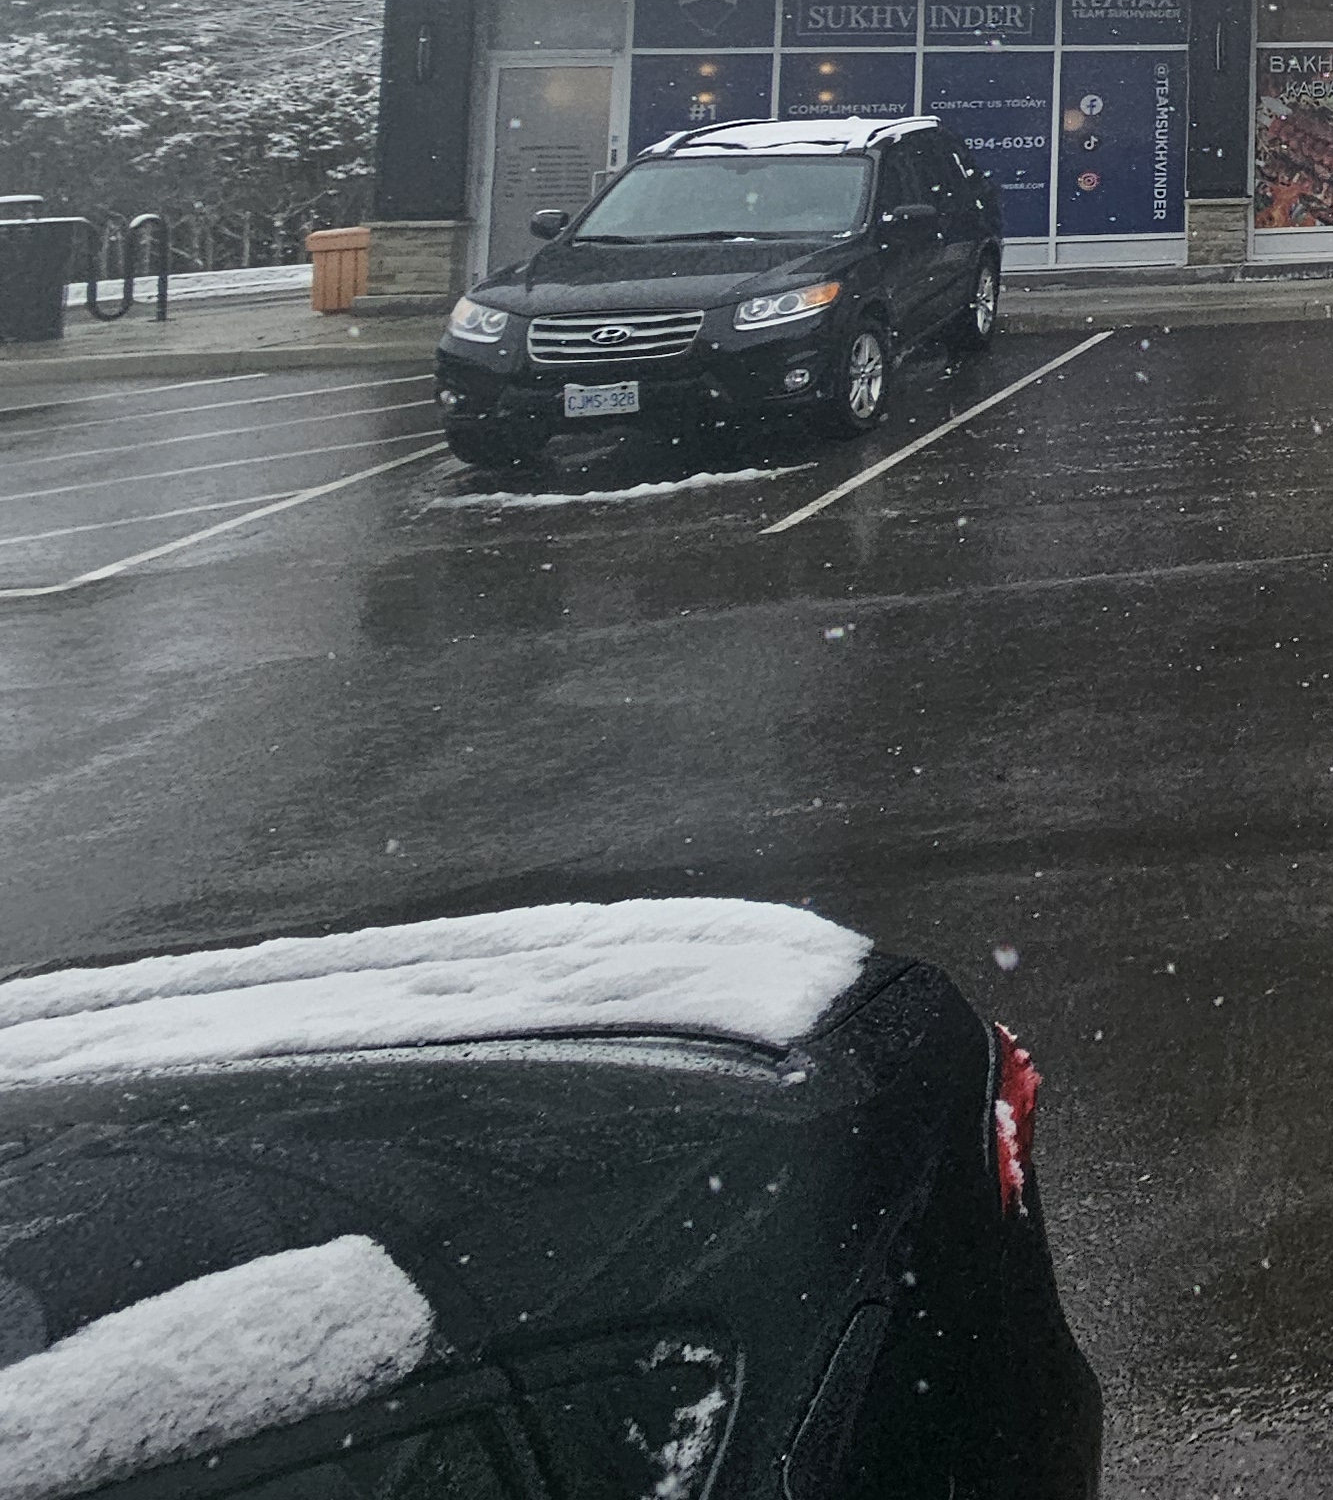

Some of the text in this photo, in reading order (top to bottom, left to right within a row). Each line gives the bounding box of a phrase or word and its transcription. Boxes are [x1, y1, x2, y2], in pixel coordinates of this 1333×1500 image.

[1071, 8, 1181, 19] TEAM SUKHVINDER
[788, 103, 907, 115] COMPLIMENTARY
[930, 100, 984, 110] CONTACT
[987, 100, 1002, 109] US
[689, 104, 717, 121] #1
[1153, 62, 1169, 221] @TEAMSUKHVINDER
